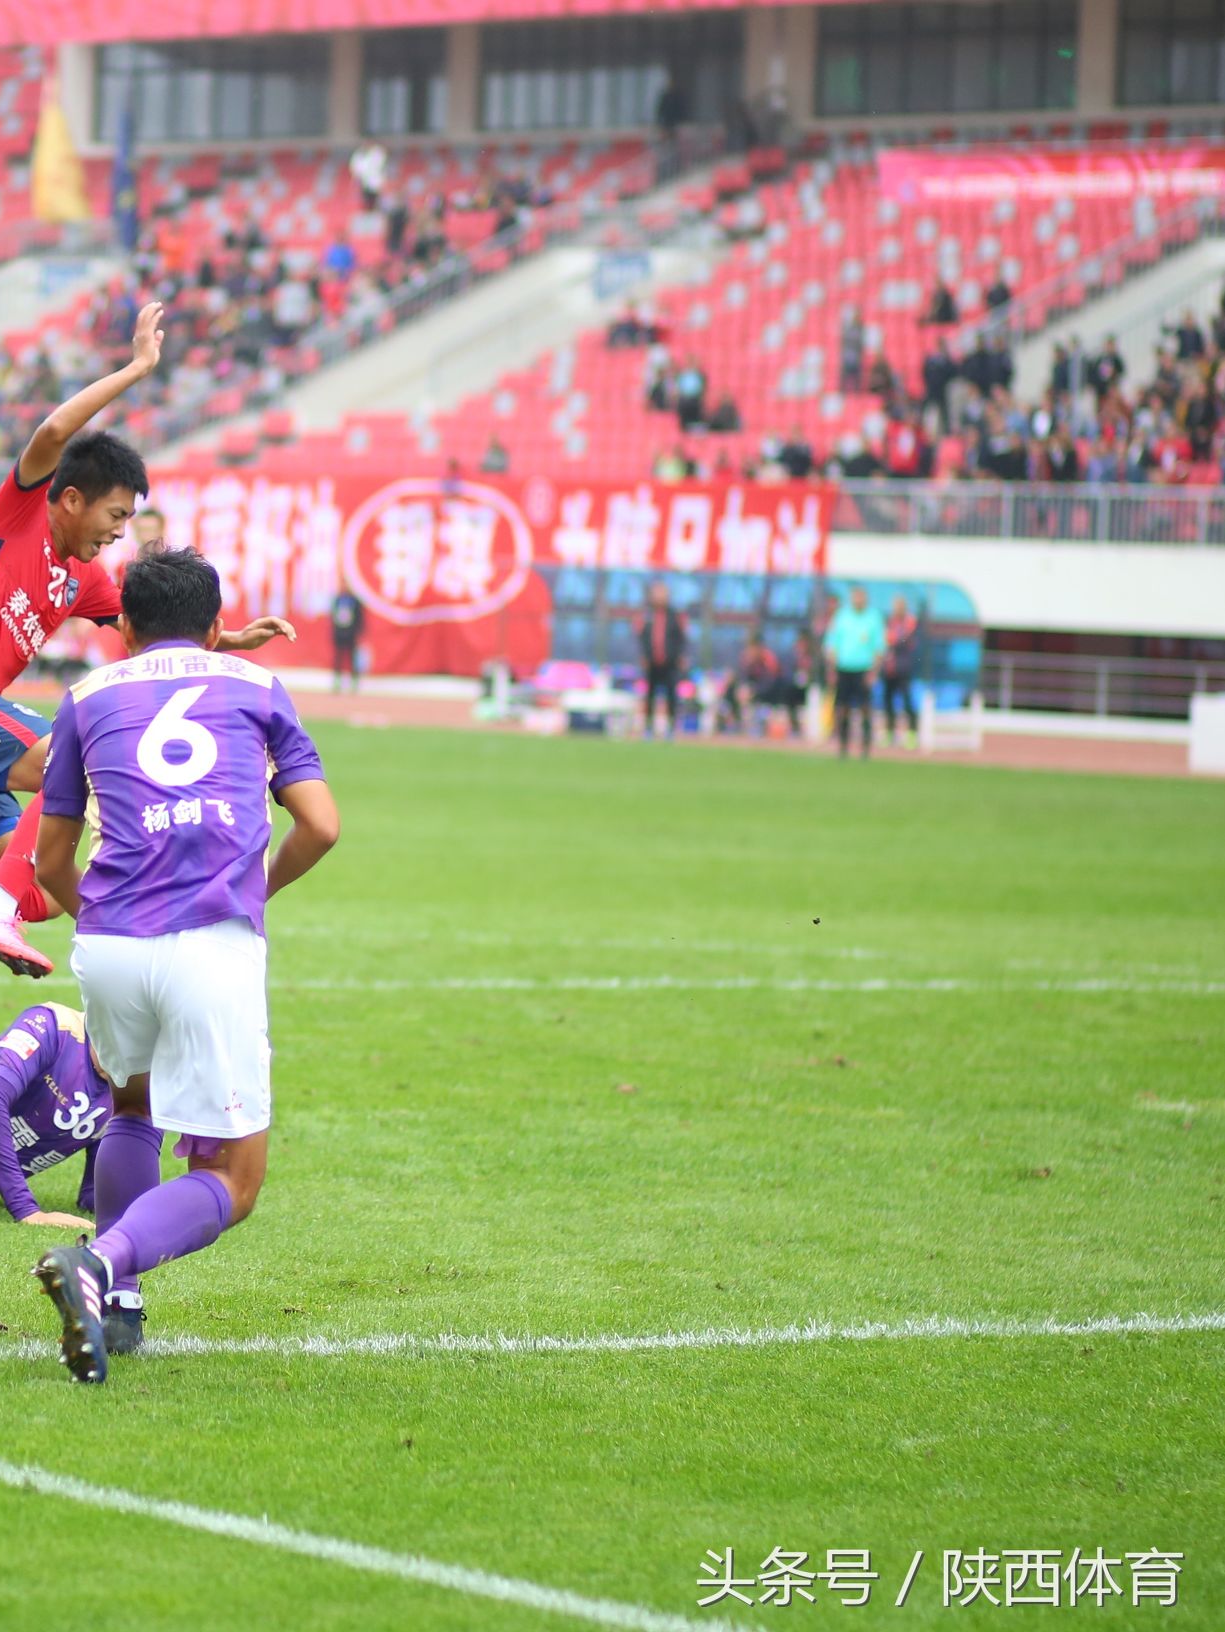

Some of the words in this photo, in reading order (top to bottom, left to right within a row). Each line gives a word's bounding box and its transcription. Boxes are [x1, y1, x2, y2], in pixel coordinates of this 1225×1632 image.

[136, 684, 218, 787] 6
[142, 797, 235, 834] 杨剑飞
[53, 1090, 108, 1141] 36
